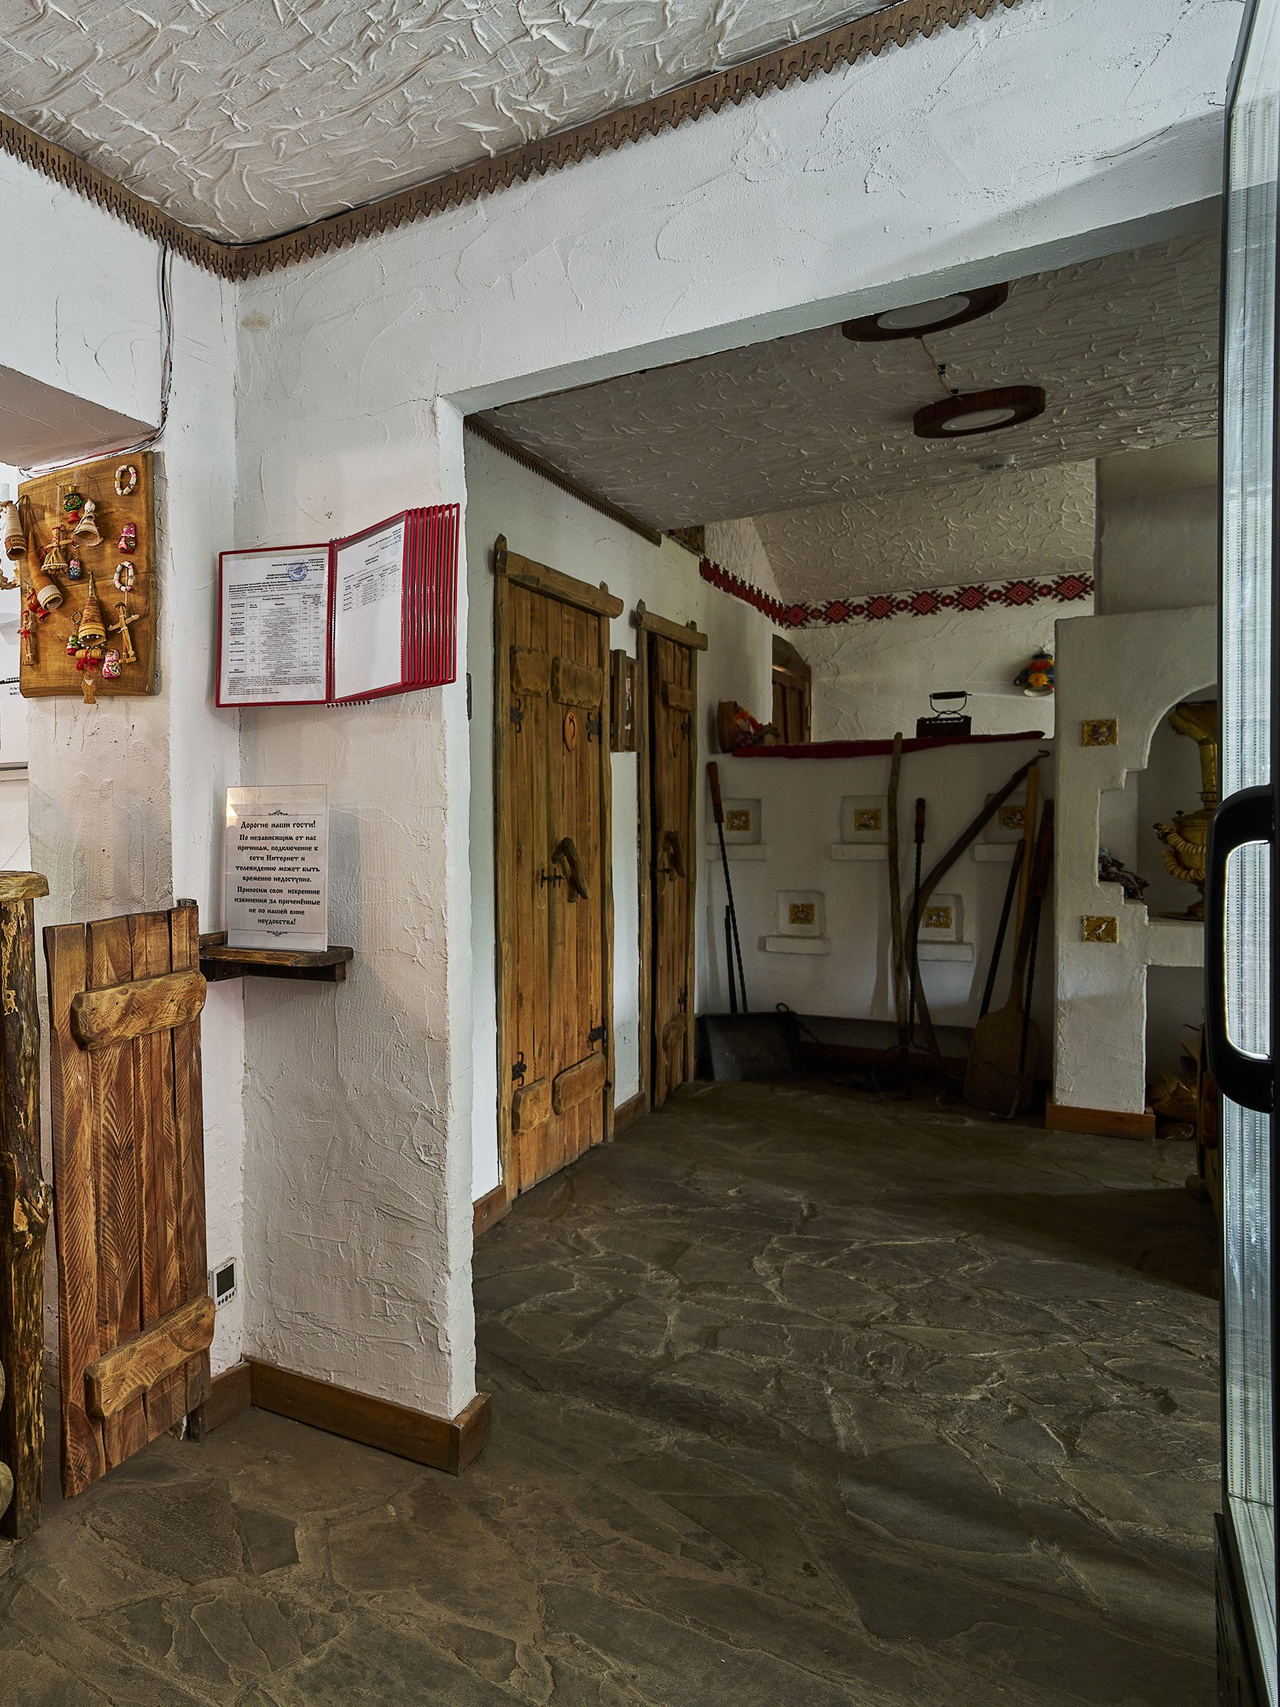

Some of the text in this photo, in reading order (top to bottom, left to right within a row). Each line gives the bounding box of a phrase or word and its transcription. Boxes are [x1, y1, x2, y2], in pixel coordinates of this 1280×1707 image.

[241, 821, 269, 831] Дорогие
[293, 820, 316, 828] гости!
[266, 854, 299, 862] Интернет
[273, 876, 312, 884] недоступно.
[257, 918, 296, 926] неудобства!
